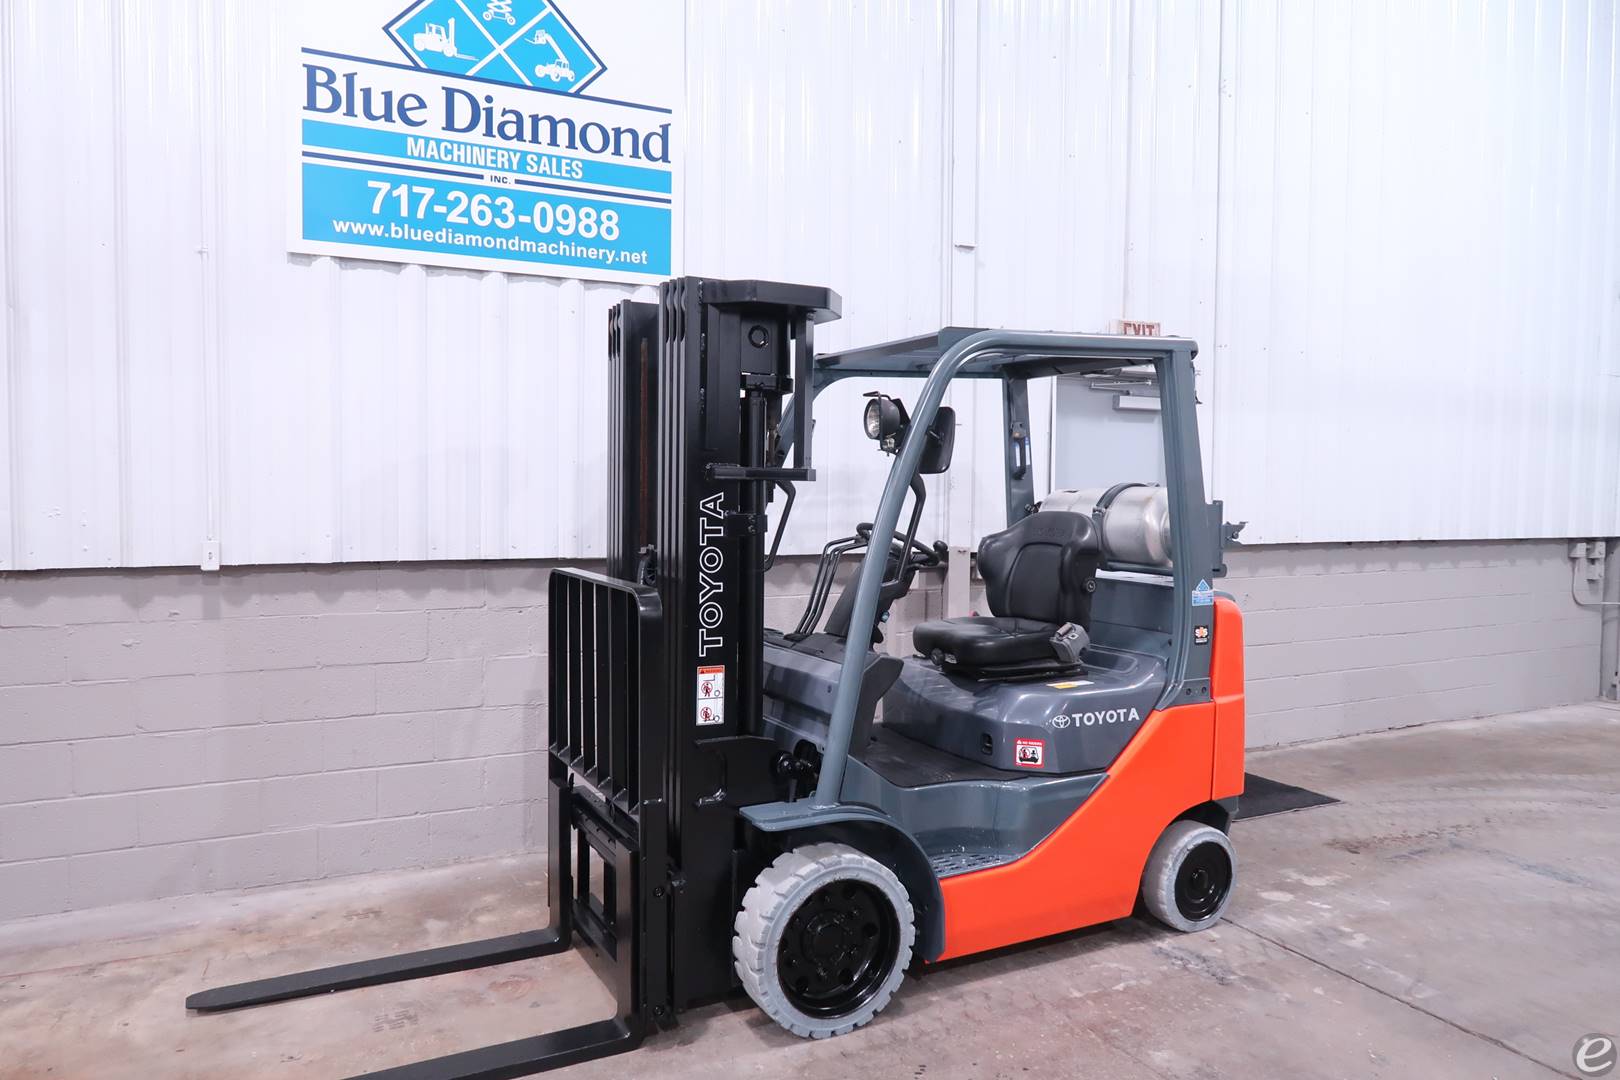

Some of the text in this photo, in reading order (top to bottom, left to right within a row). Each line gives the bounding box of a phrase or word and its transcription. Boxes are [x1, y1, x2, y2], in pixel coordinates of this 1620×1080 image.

[302, 63, 671, 163] Blue Diamond
[406, 136, 583, 179] MACHINERY SALES
[489, 174, 512, 185] INC.
[367, 180, 620, 241] 717-263-0988
[332, 219, 648, 265] www.bluediamondmachinery.net
[699, 492, 725, 658] TOYOTA
[1071, 707, 1140, 728] TOYOTA
